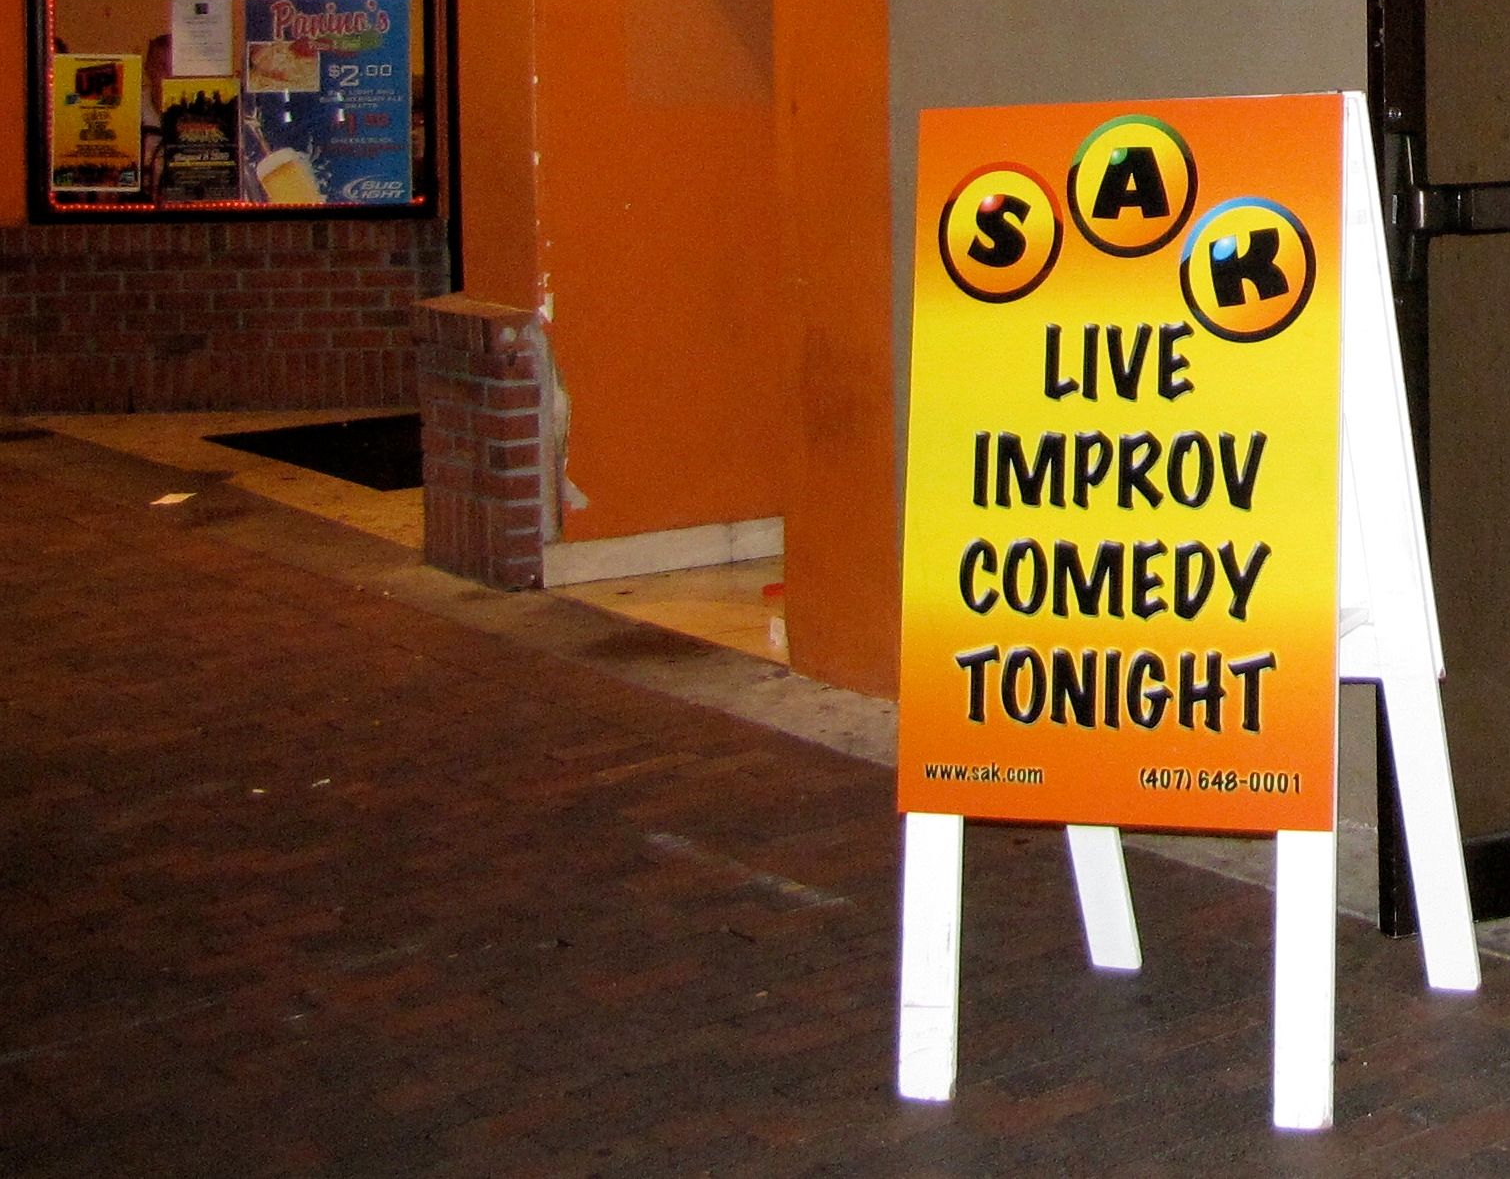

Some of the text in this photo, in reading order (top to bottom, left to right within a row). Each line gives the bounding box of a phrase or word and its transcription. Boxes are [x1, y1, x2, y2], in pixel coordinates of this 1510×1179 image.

[361, 181, 403, 189] BUD
[968, 146, 1290, 308] SAK
[1042, 320, 1195, 402] LIVE
[972, 429, 1269, 513] IMPROV
[958, 537, 1272, 623] COMEDY
[955, 644, 1277, 734] TONIGHT
[925, 763, 1301, 794] www.sak.com (407) 648-0001
